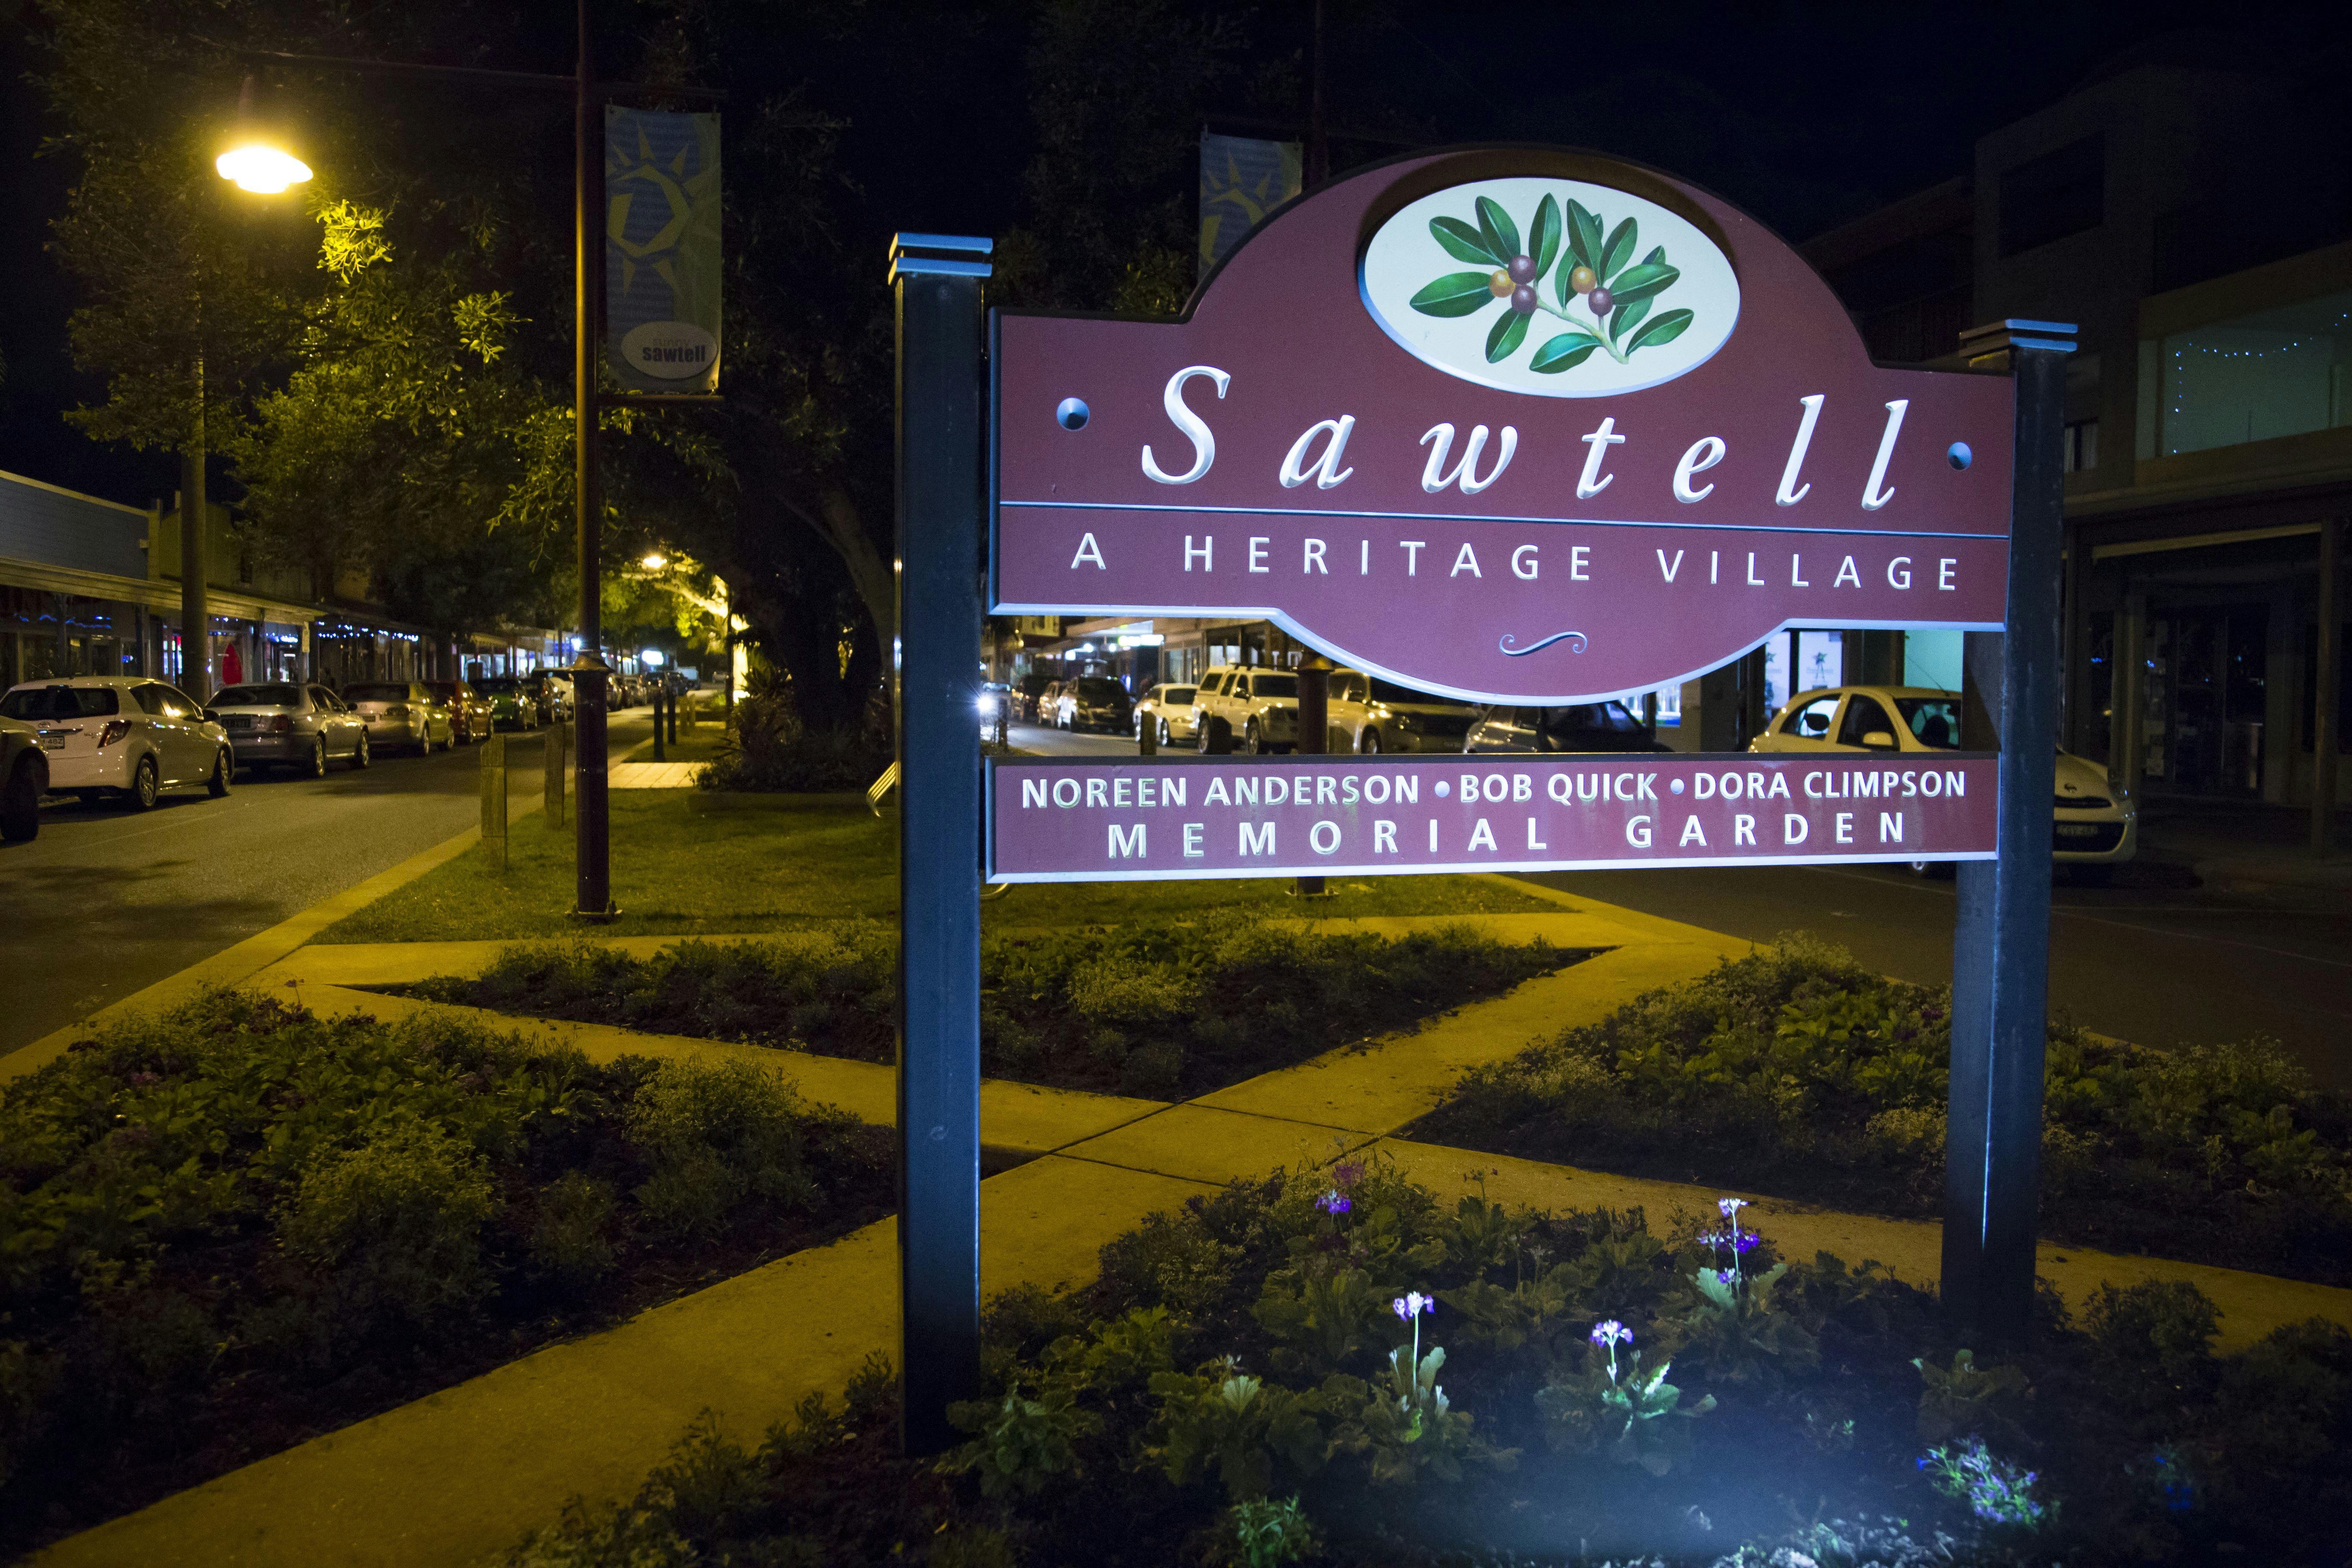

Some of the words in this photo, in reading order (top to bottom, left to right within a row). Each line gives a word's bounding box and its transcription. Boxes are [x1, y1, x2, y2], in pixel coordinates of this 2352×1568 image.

[643, 345, 705, 362] sawtell
[1142, 366, 1908, 510] Sawtell
[1071, 533, 1106, 570] A
[1185, 536, 1590, 580] HERITAGE
[1657, 549, 1956, 590] VILLAGE
[1023, 778, 1186, 808] NOREEN
[1204, 775, 1418, 806] ANDERSON
[1461, 774, 1532, 803] BOB
[1547, 773, 1657, 805] QUICK
[1695, 772, 1790, 800] DORA
[1804, 771, 1964, 799] CLIMPSON
[1109, 818, 1547, 858] MEMORIAL
[1626, 812, 1902, 848] GARDEN
